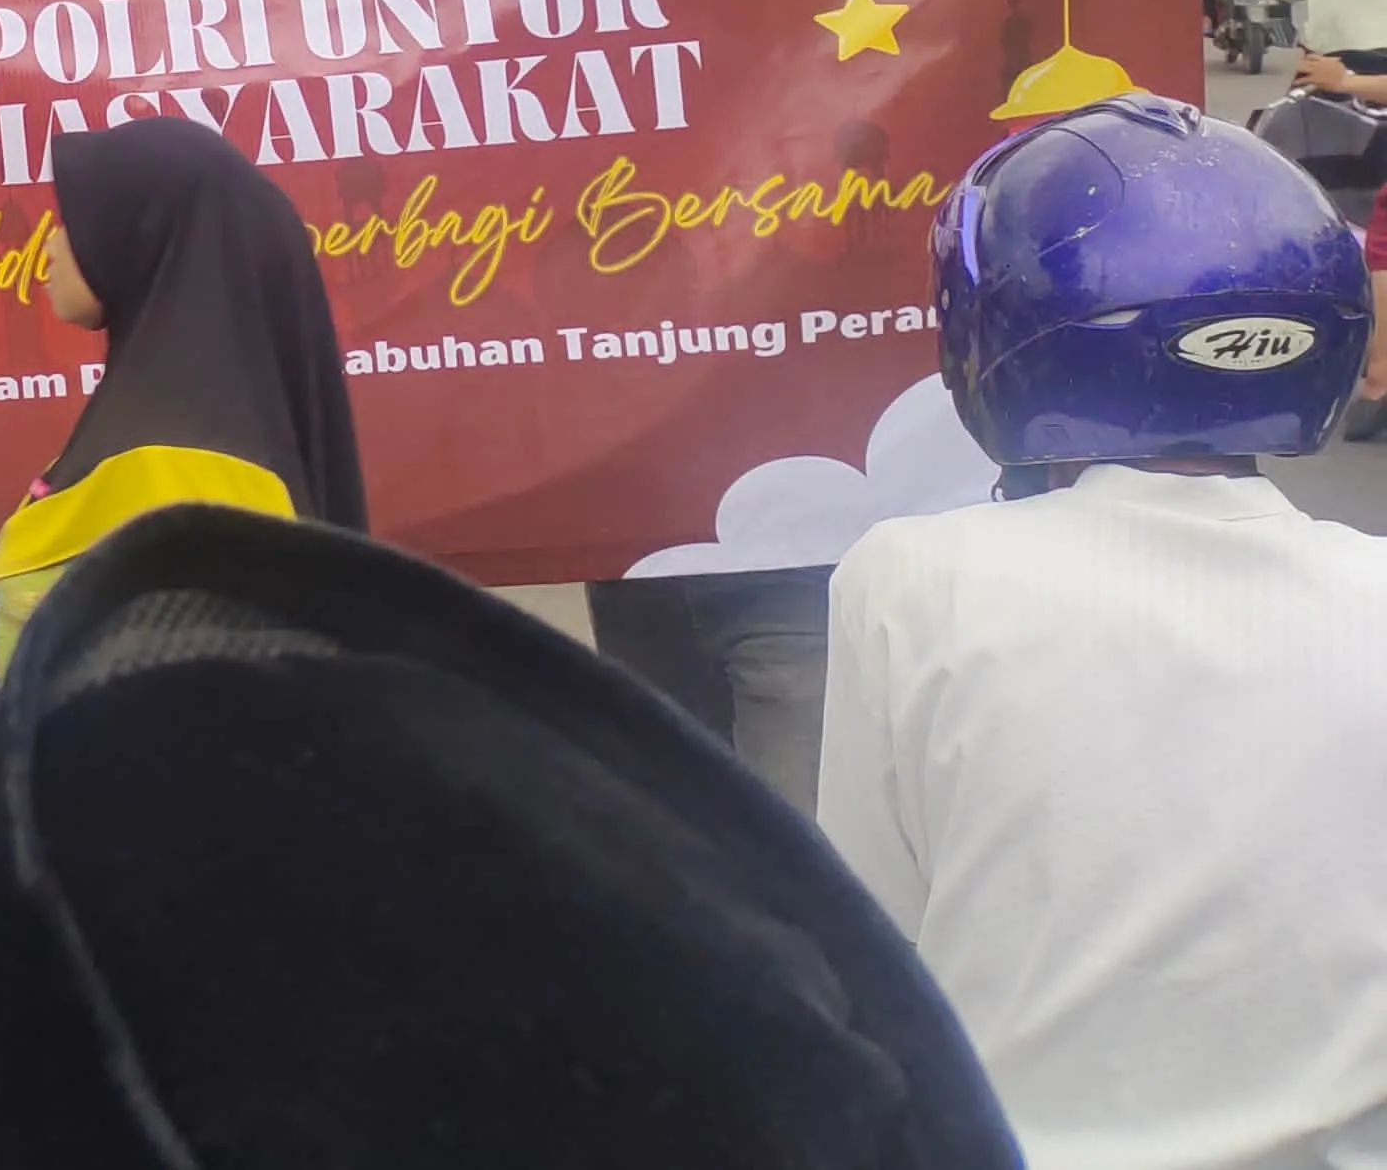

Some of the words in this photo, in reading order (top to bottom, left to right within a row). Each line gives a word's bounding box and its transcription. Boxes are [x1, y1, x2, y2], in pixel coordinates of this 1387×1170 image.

[577, 155, 955, 274] Bersama
[556, 320, 786, 365] Tanjung
[1204, 329, 1291, 360] Hiu
